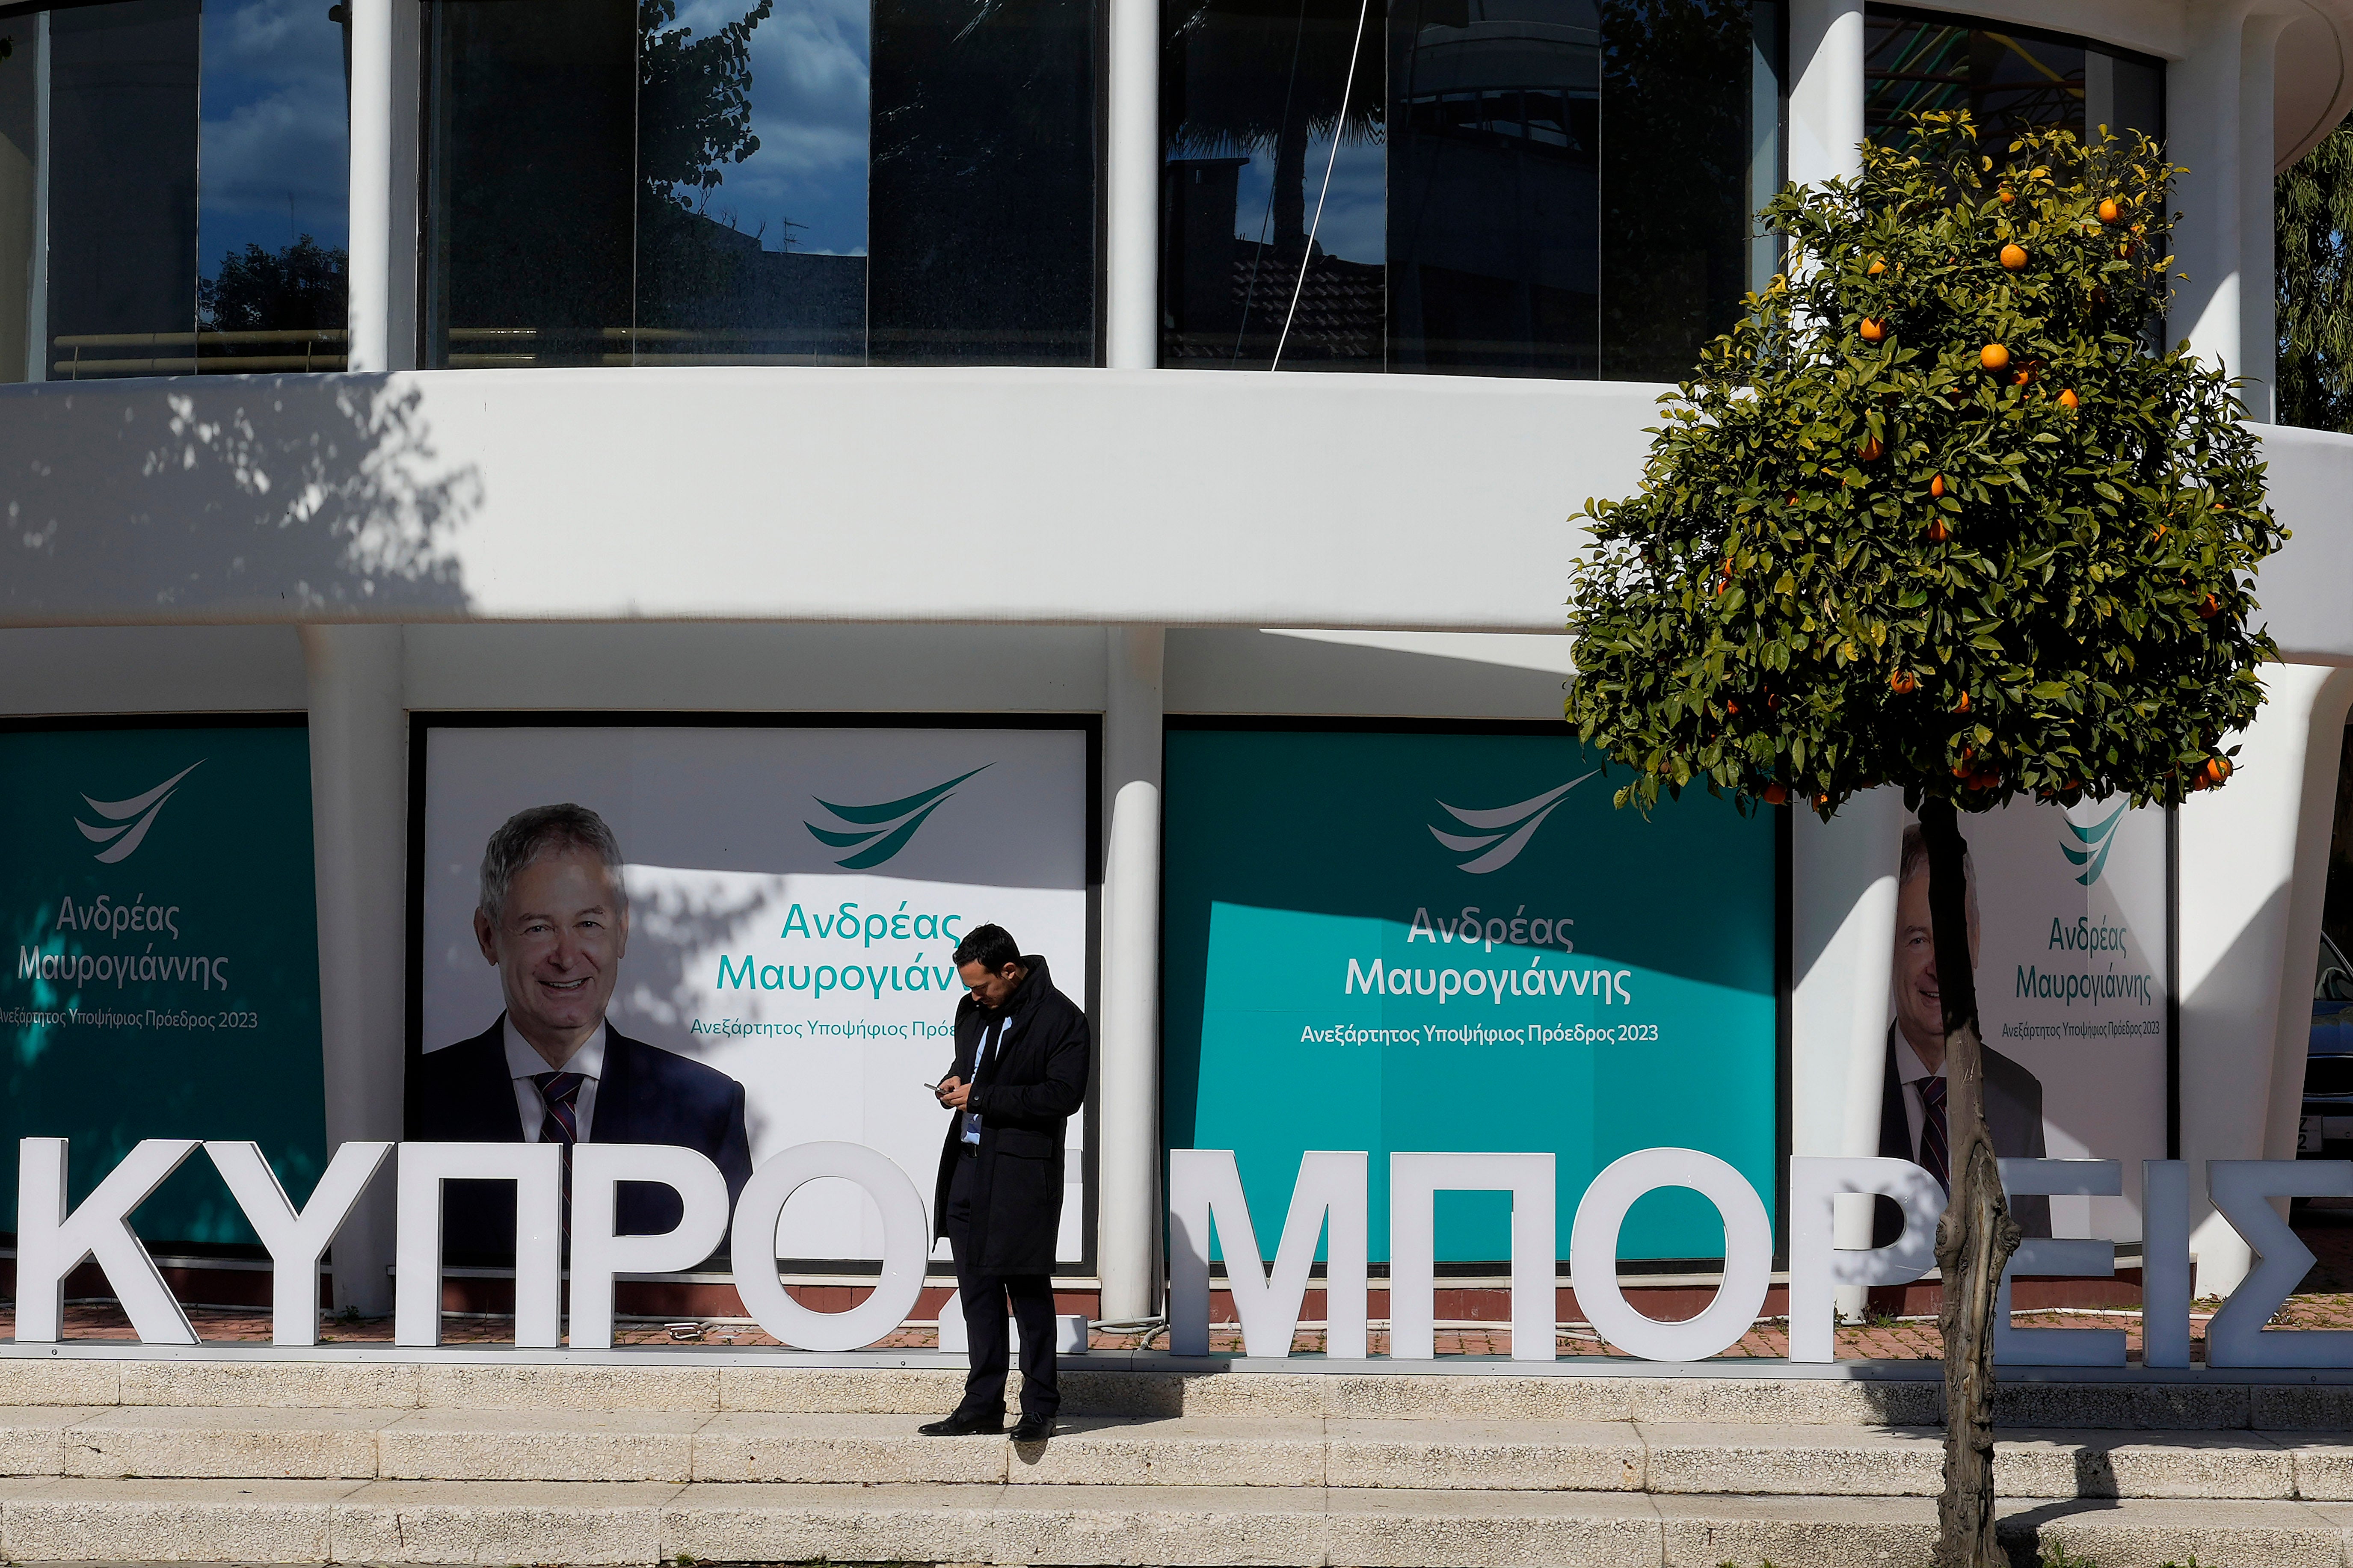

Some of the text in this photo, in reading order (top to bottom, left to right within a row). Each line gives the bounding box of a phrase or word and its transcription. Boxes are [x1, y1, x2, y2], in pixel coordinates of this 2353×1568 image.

[56, 893, 179, 940] Ανδρέας
[781, 901, 961, 948] Ανδρέας
[1407, 905, 1575, 953] Ανδρέας
[2048, 915, 2127, 959] Ανδρέας
[18, 943, 229, 991] Μαυρογιάννης
[716, 953, 970, 999] Μαυρογιάν
[1345, 956, 1631, 1005] Μαυρογιάννης
[2016, 962, 2151, 1006] Μαυρογιάννης
[68, 1007, 143, 1029] Υποψήφιος
[145, 1009, 215, 1031] Πρόεδρος
[218, 1012, 258, 1029] 2023
[690, 1018, 955, 1040] Ανεξάρτητος Υποψήφιος Πρόε
[1301, 1023, 1659, 1047] Ανεξάρτητος Υποψήφιος Πρόεδρος 2023
[2002, 1020, 2160, 1040] Ανεξάρτητος Υποψήφιος Πρόεδρος 2023
[15, 1137, 2353, 1368] ΚΥΠΡΟ ΜΠΟΡΕΙΣ
